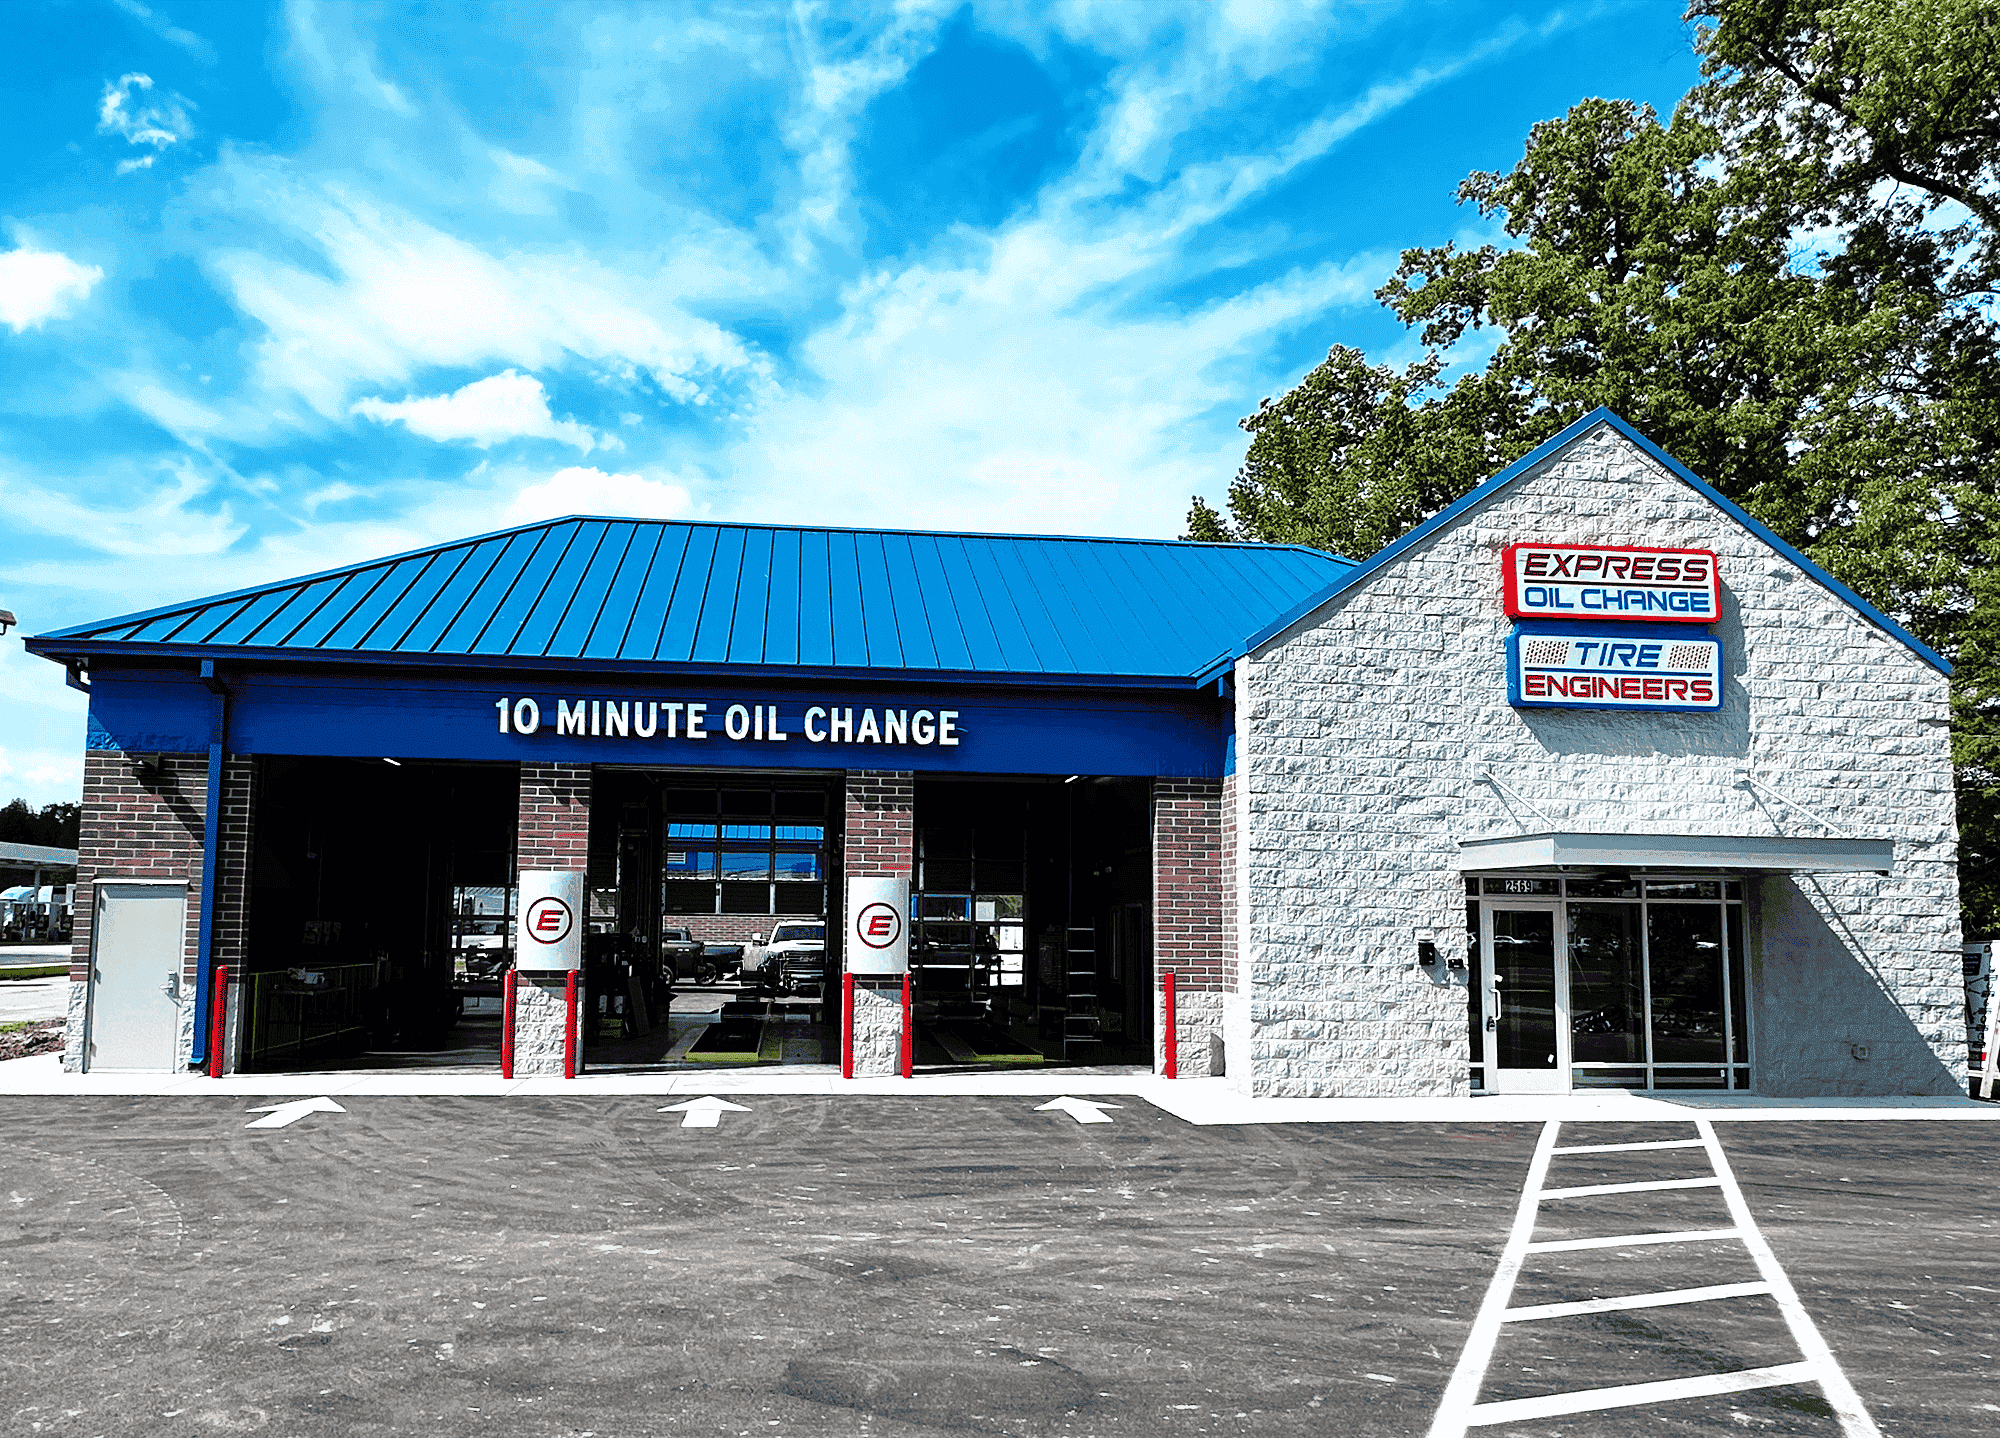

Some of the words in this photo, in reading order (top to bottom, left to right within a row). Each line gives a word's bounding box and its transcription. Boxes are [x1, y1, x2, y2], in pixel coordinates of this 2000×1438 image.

[1524, 553, 1708, 581] EXPRESS
[1525, 587, 1574, 608] OIL
[1581, 589, 1710, 612] CHANGE
[1575, 642, 1663, 667] TIRE
[1525, 675, 1713, 701] ENGINEERS
[496, 697, 540, 734] 10
[556, 700, 708, 739] MINUTE
[725, 704, 786, 741] OIL
[804, 707, 960, 746] CHANGE
[1506, 880, 1533, 892] 2569
[536, 910, 564, 931] E
[867, 916, 894, 936] E
